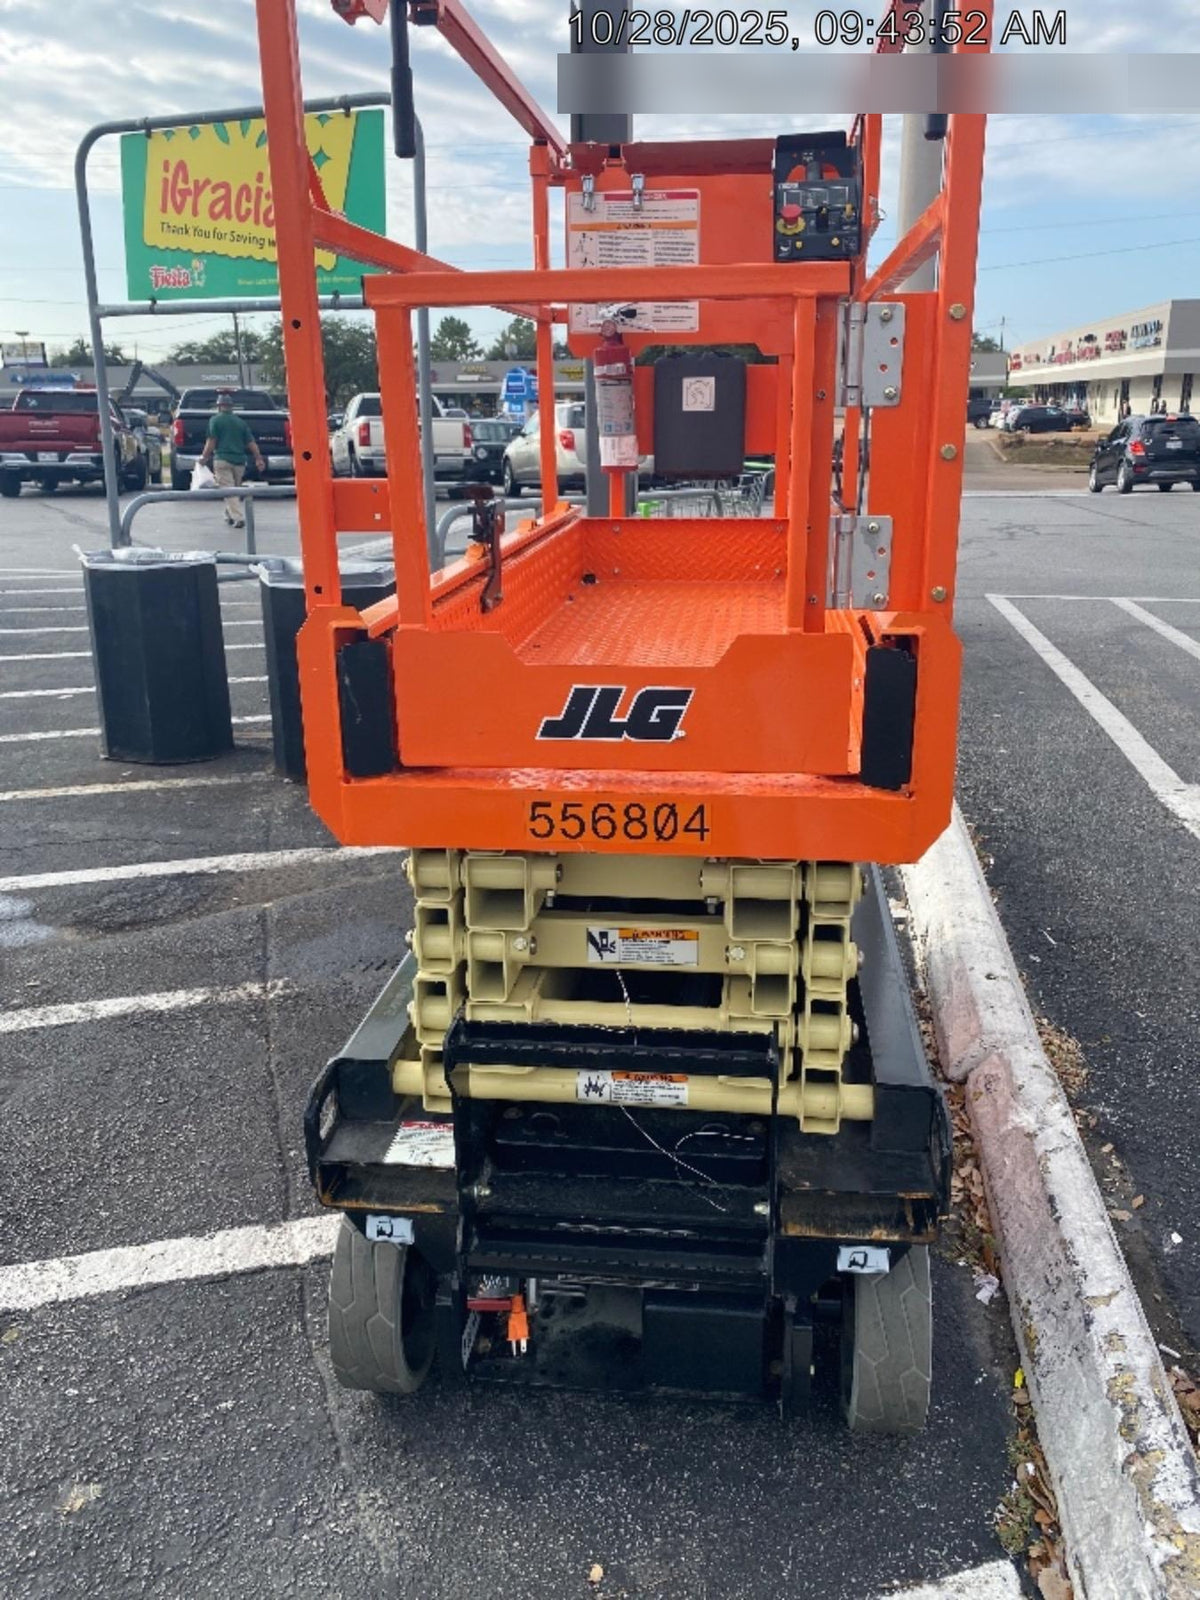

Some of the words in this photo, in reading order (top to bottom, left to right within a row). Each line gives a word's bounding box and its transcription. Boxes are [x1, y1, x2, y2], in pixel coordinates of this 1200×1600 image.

[160, 222, 190, 236] Thank
[192, 225, 211, 239] You
[212, 227, 227, 241] for
[229, 231, 266, 249] Saving
[150, 265, 192, 290] Fiesta
[535, 684, 695, 742] JLG
